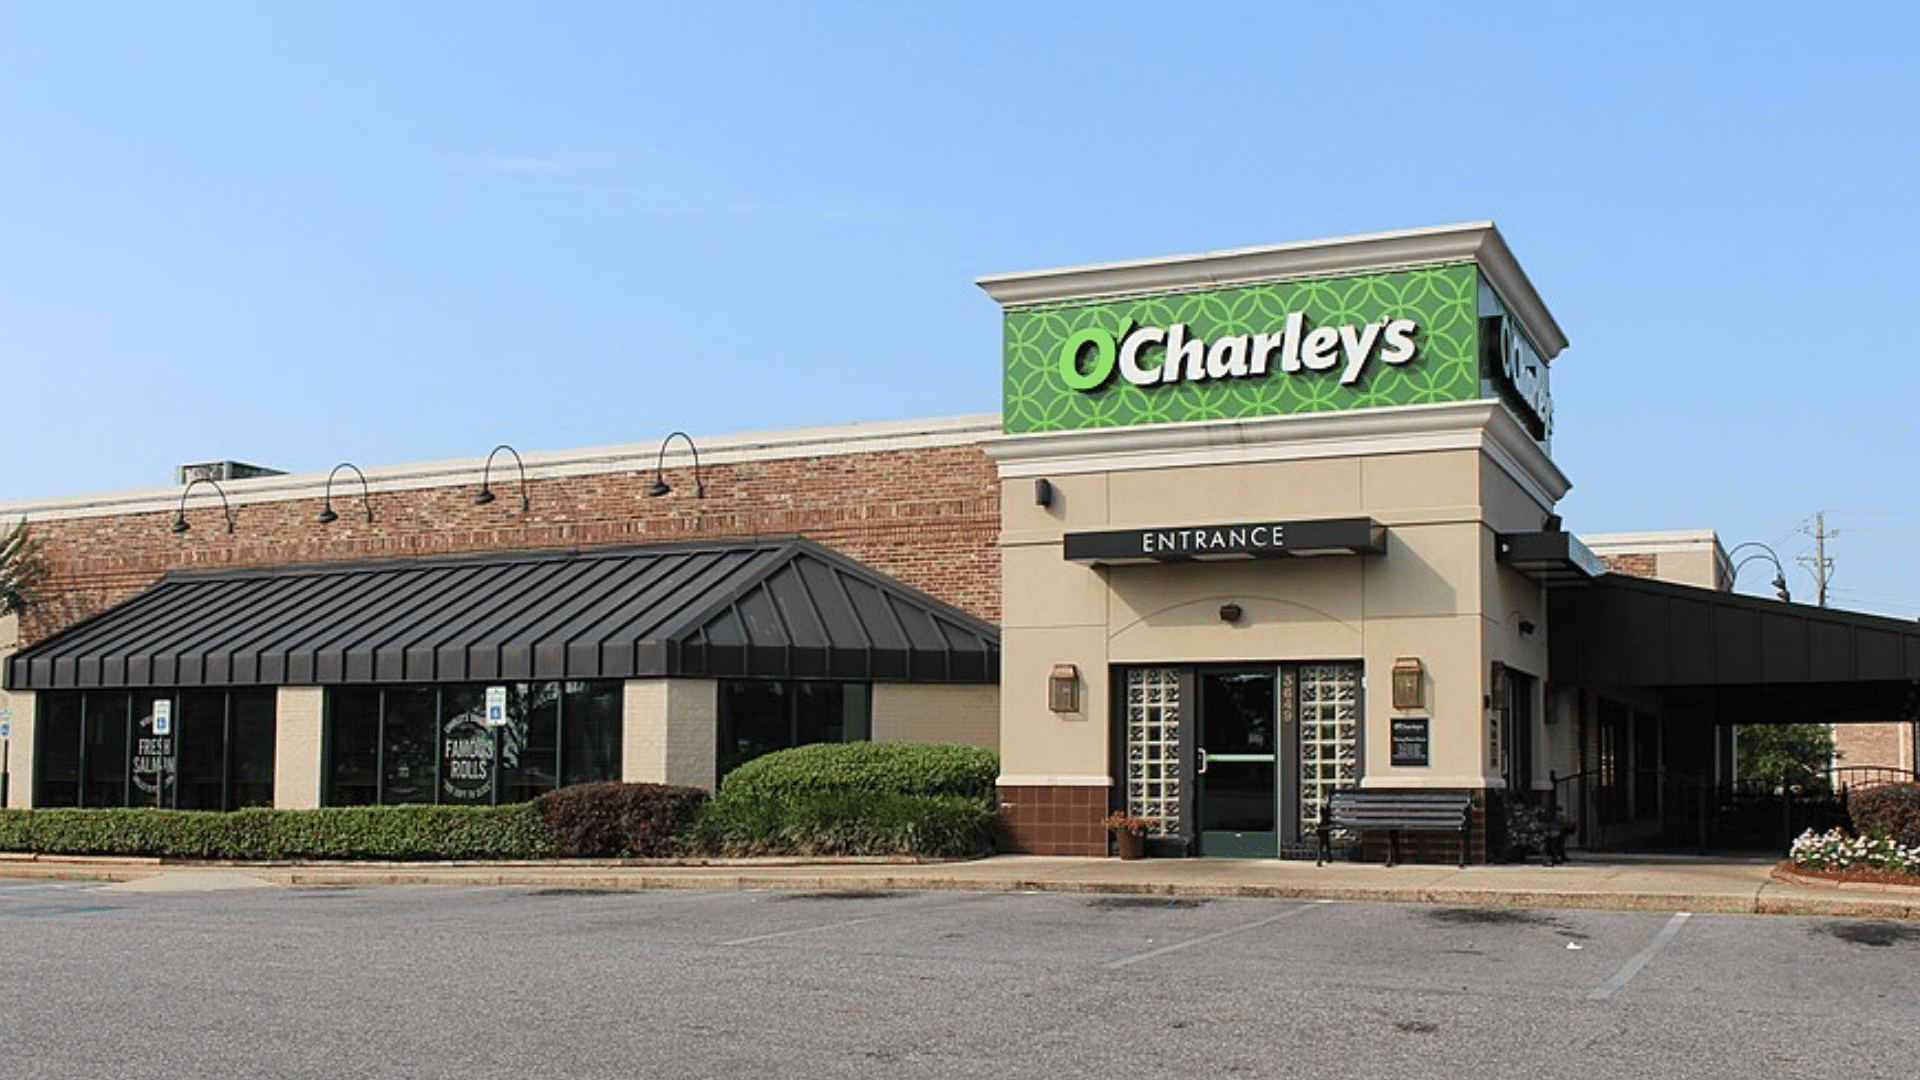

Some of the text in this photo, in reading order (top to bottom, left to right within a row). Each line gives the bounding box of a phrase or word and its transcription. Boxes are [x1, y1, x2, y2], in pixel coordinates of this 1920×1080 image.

[1059, 311, 1416, 390] O'Charley's
[1142, 526, 1284, 552] ENTRANCE
[138, 738, 171, 755] FRESH
[445, 739, 493, 759] FAMOUS
[450, 760, 487, 779] ROLLS
